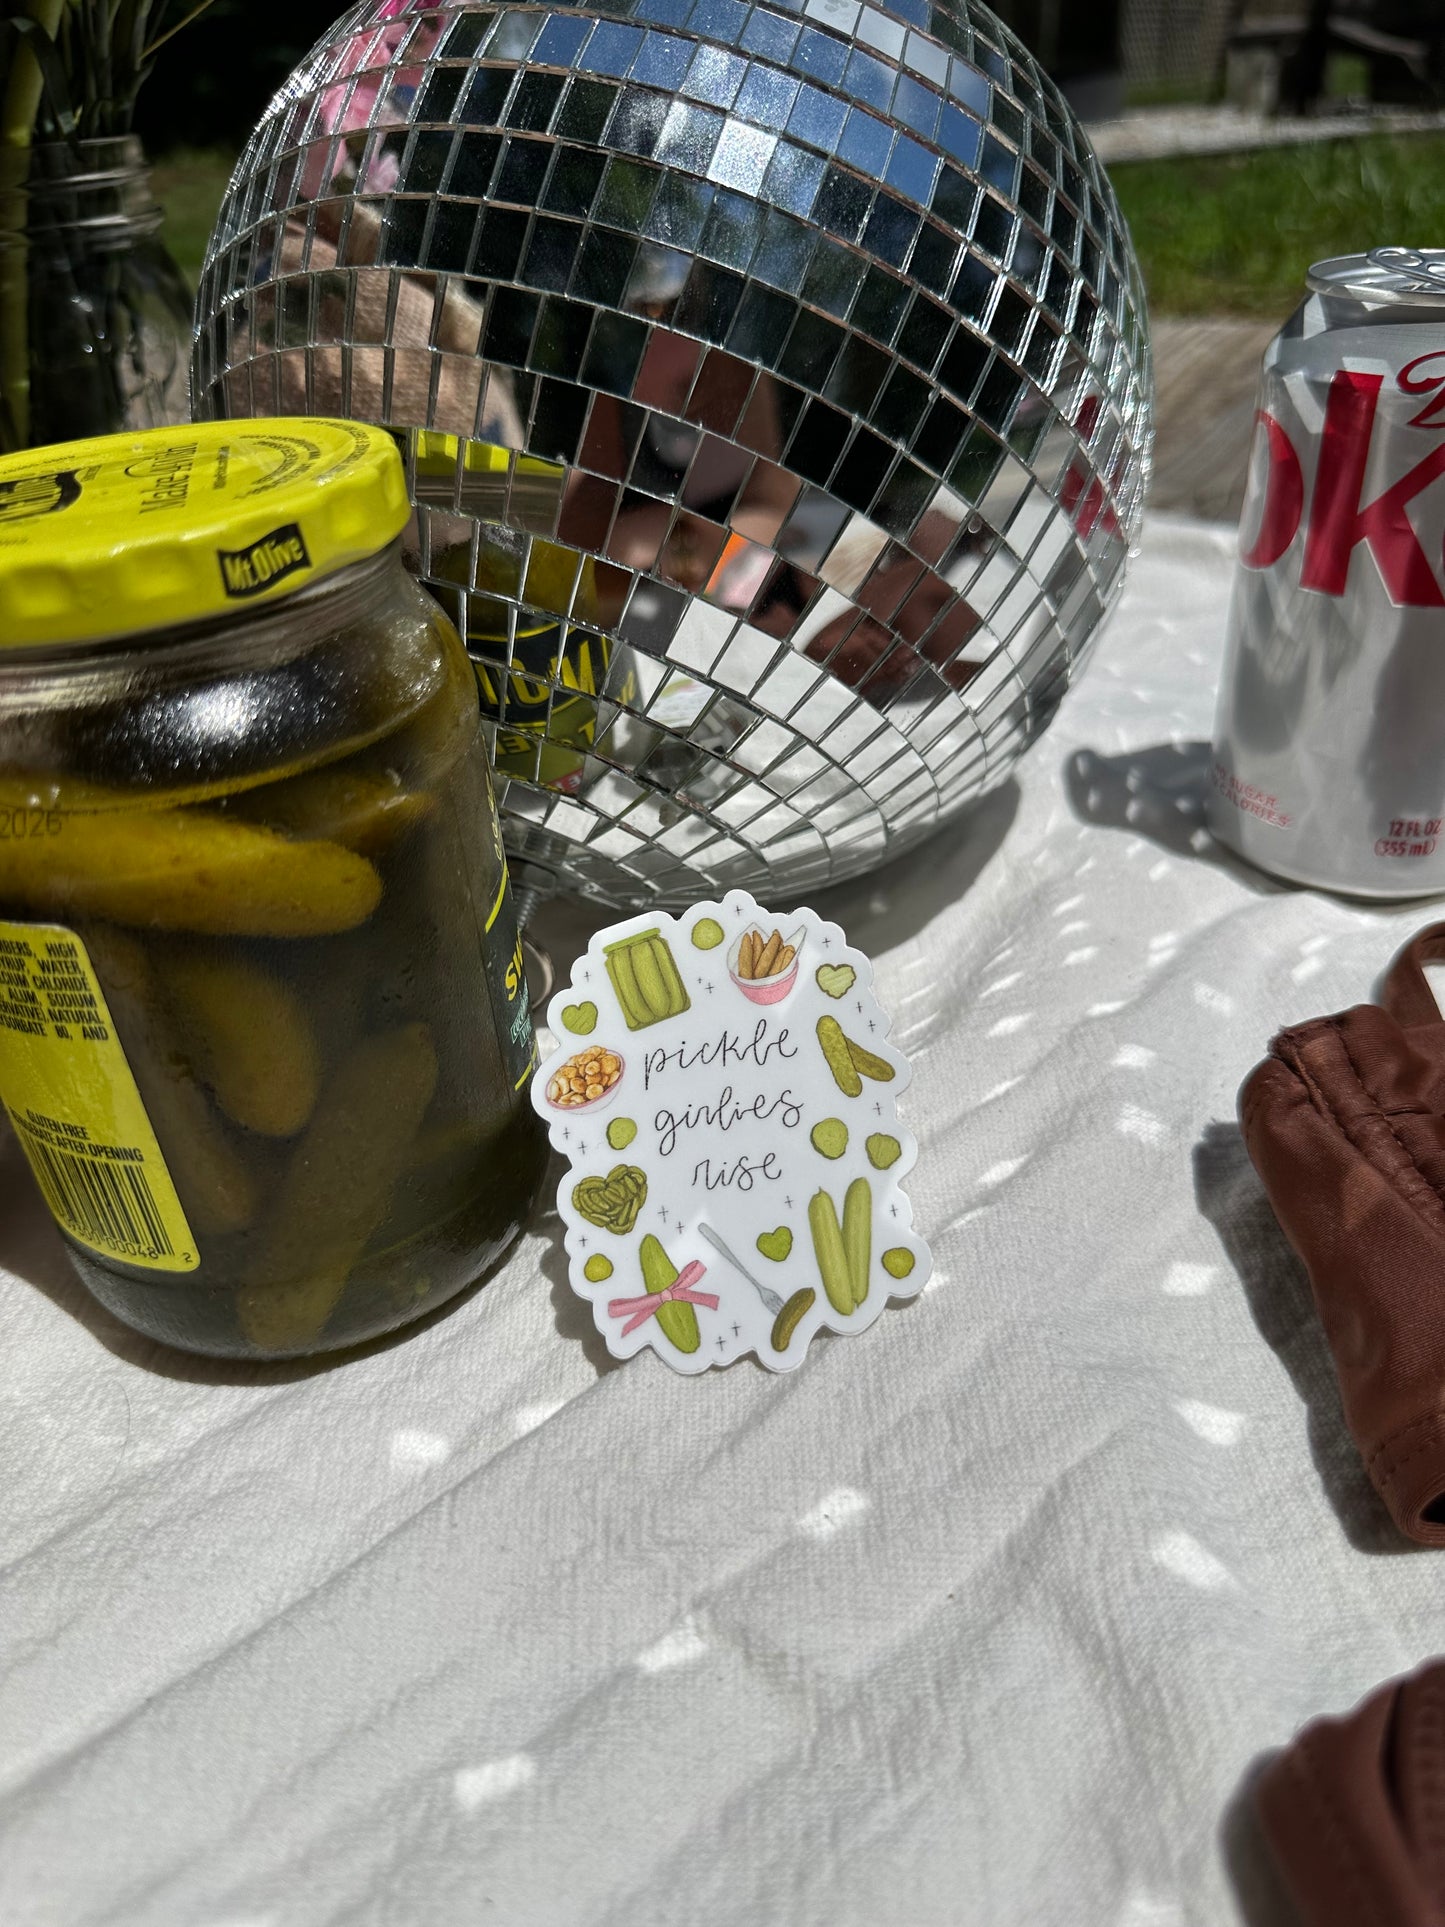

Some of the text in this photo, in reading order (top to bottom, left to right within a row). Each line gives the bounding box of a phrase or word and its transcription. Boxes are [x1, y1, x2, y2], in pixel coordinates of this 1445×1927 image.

[0, 808, 62, 839] 2026
[1388, 819, 1442, 837] 12 FL OZ
[1374, 838, 1407, 857] (355
[45, 943, 78, 958] HIGH
[37, 960, 85, 977] WATER,
[32, 976, 91, 992] CHLORIDE
[47, 992, 97, 1008] SODIUM
[47, 1008, 104, 1024] NATURAL
[82, 1025, 108, 1040] AND
[645, 1019, 798, 1090] pickle
[26, 1109, 91, 1140] GLUTEN FREE
[655, 1086, 804, 1156] girlies
[56, 1135, 88, 1154] AFTER
[88, 1143, 144, 1162] OPENING
[692, 1152, 782, 1191] rise
[182, 1252, 193, 1263] 2
